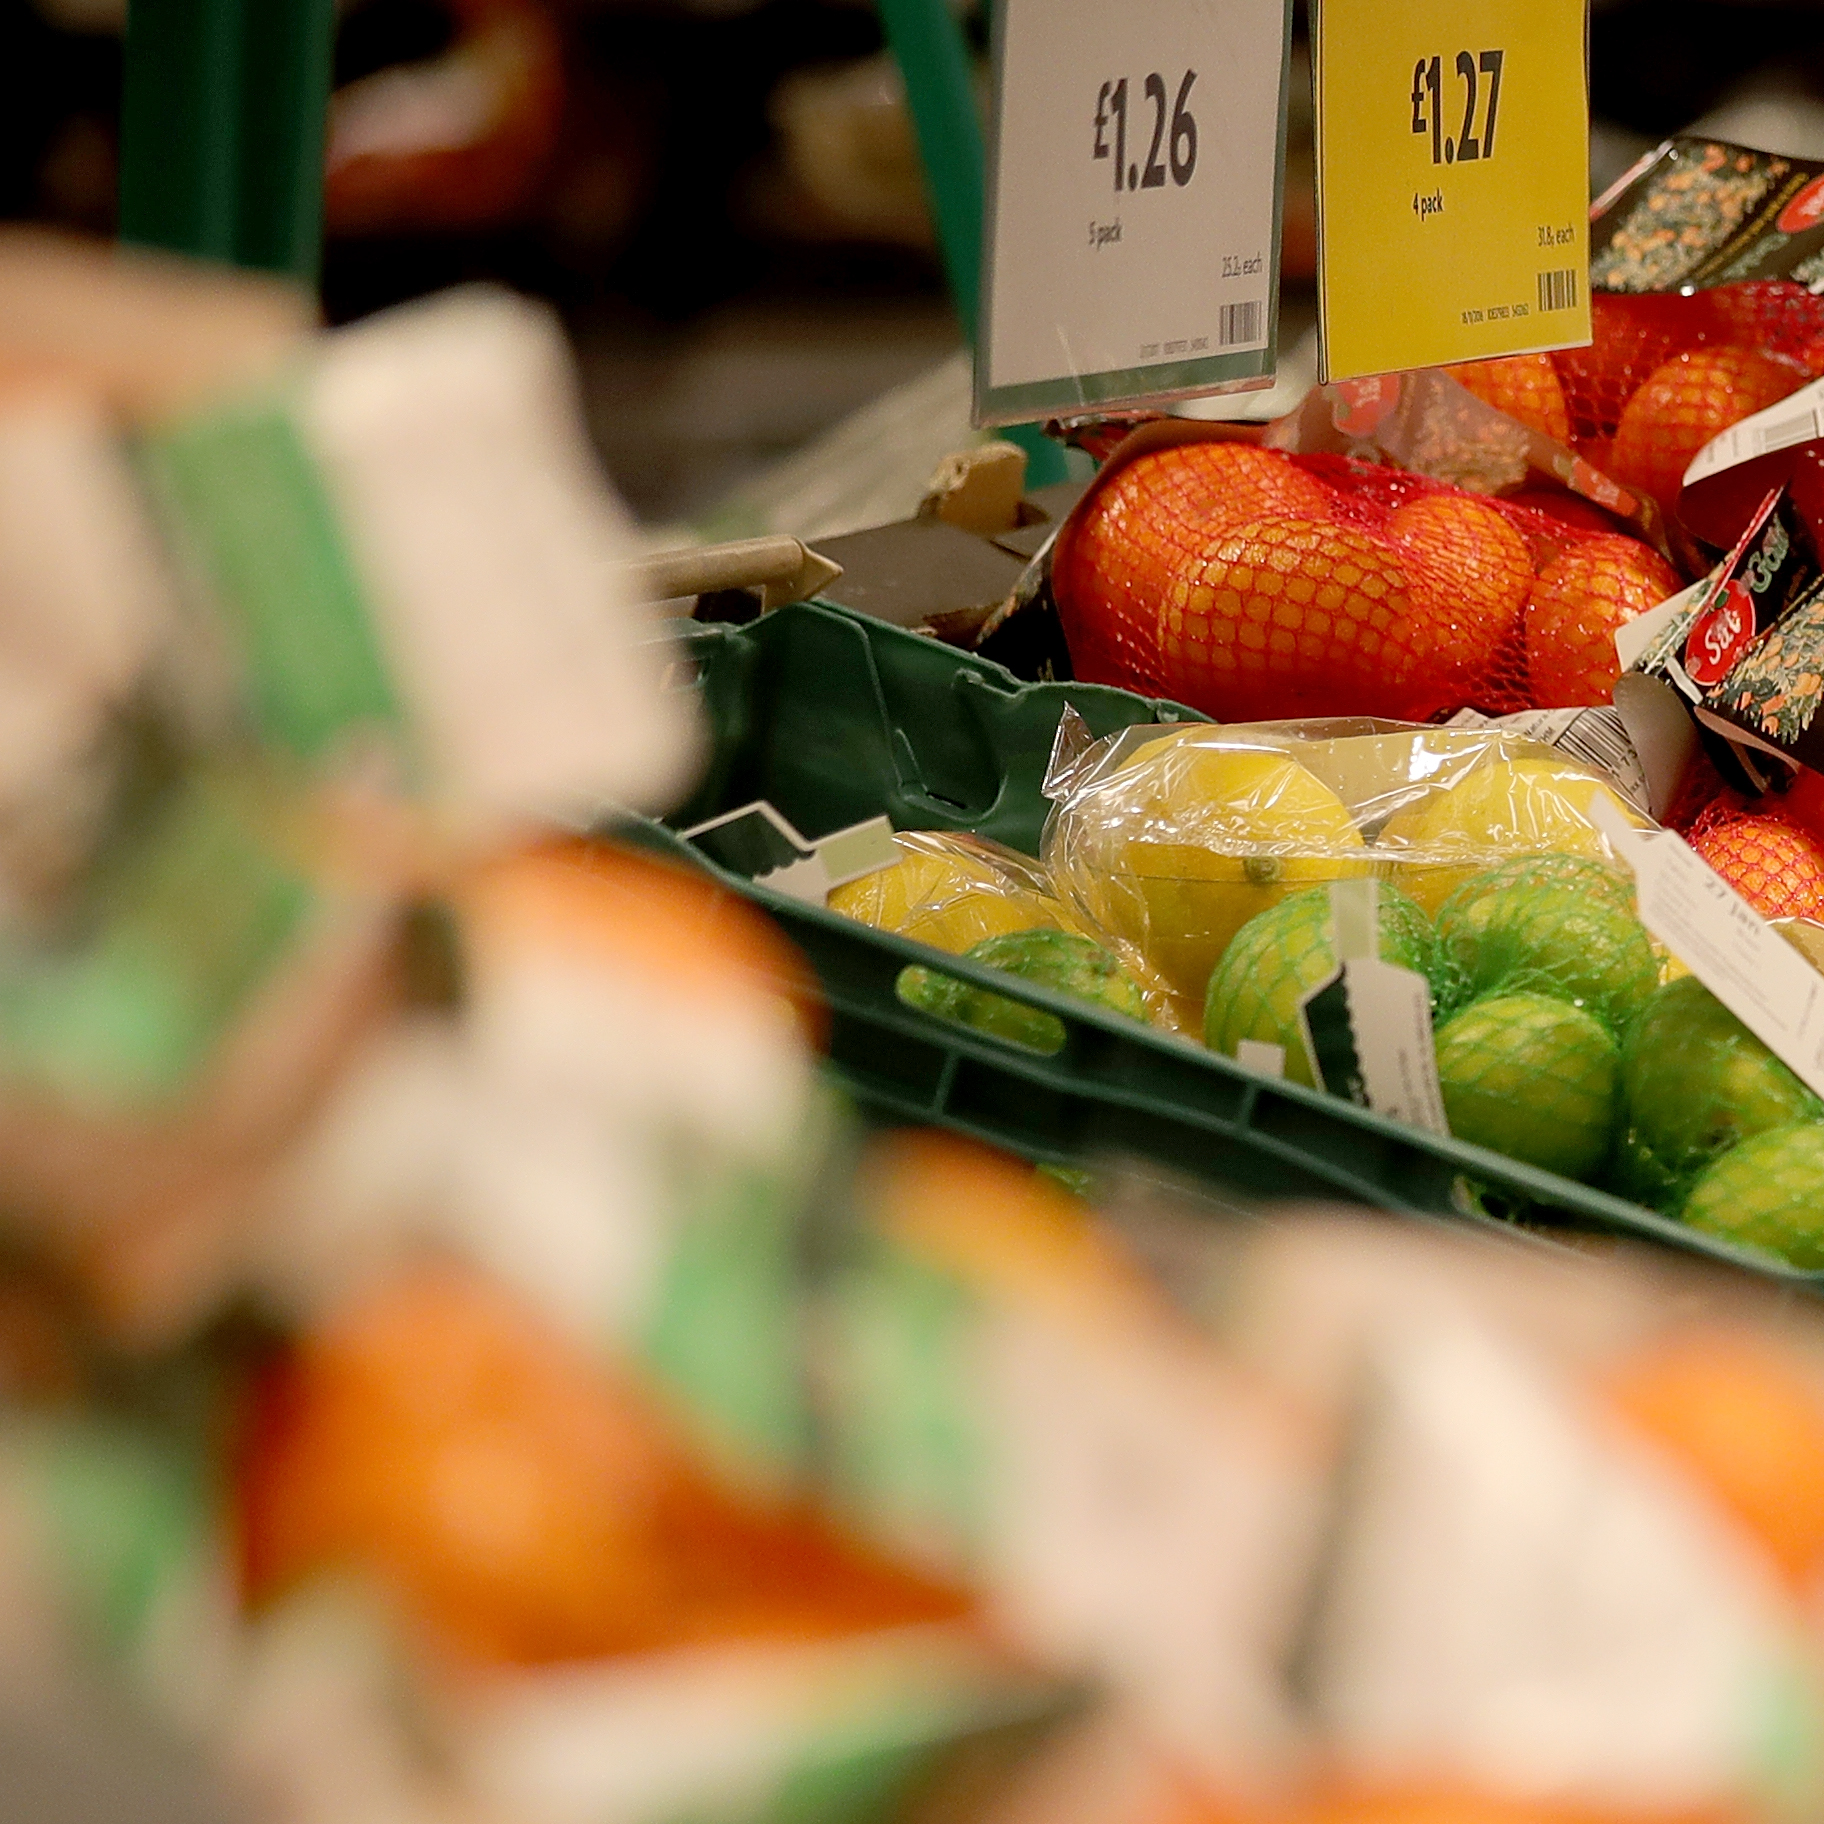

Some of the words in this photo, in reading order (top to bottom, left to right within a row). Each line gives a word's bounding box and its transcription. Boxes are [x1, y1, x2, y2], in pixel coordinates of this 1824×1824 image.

[1411, 50, 1504, 164] £1.27
[1093, 68, 1198, 192] £1.26
[1412, 192, 1419, 216] 4
[1421, 187, 1443, 222] pack
[1097, 217, 1123, 250] pack
[1556, 223, 1574, 245] each
[1242, 252, 1262, 274] each
[1704, 610, 1743, 665] Sat
